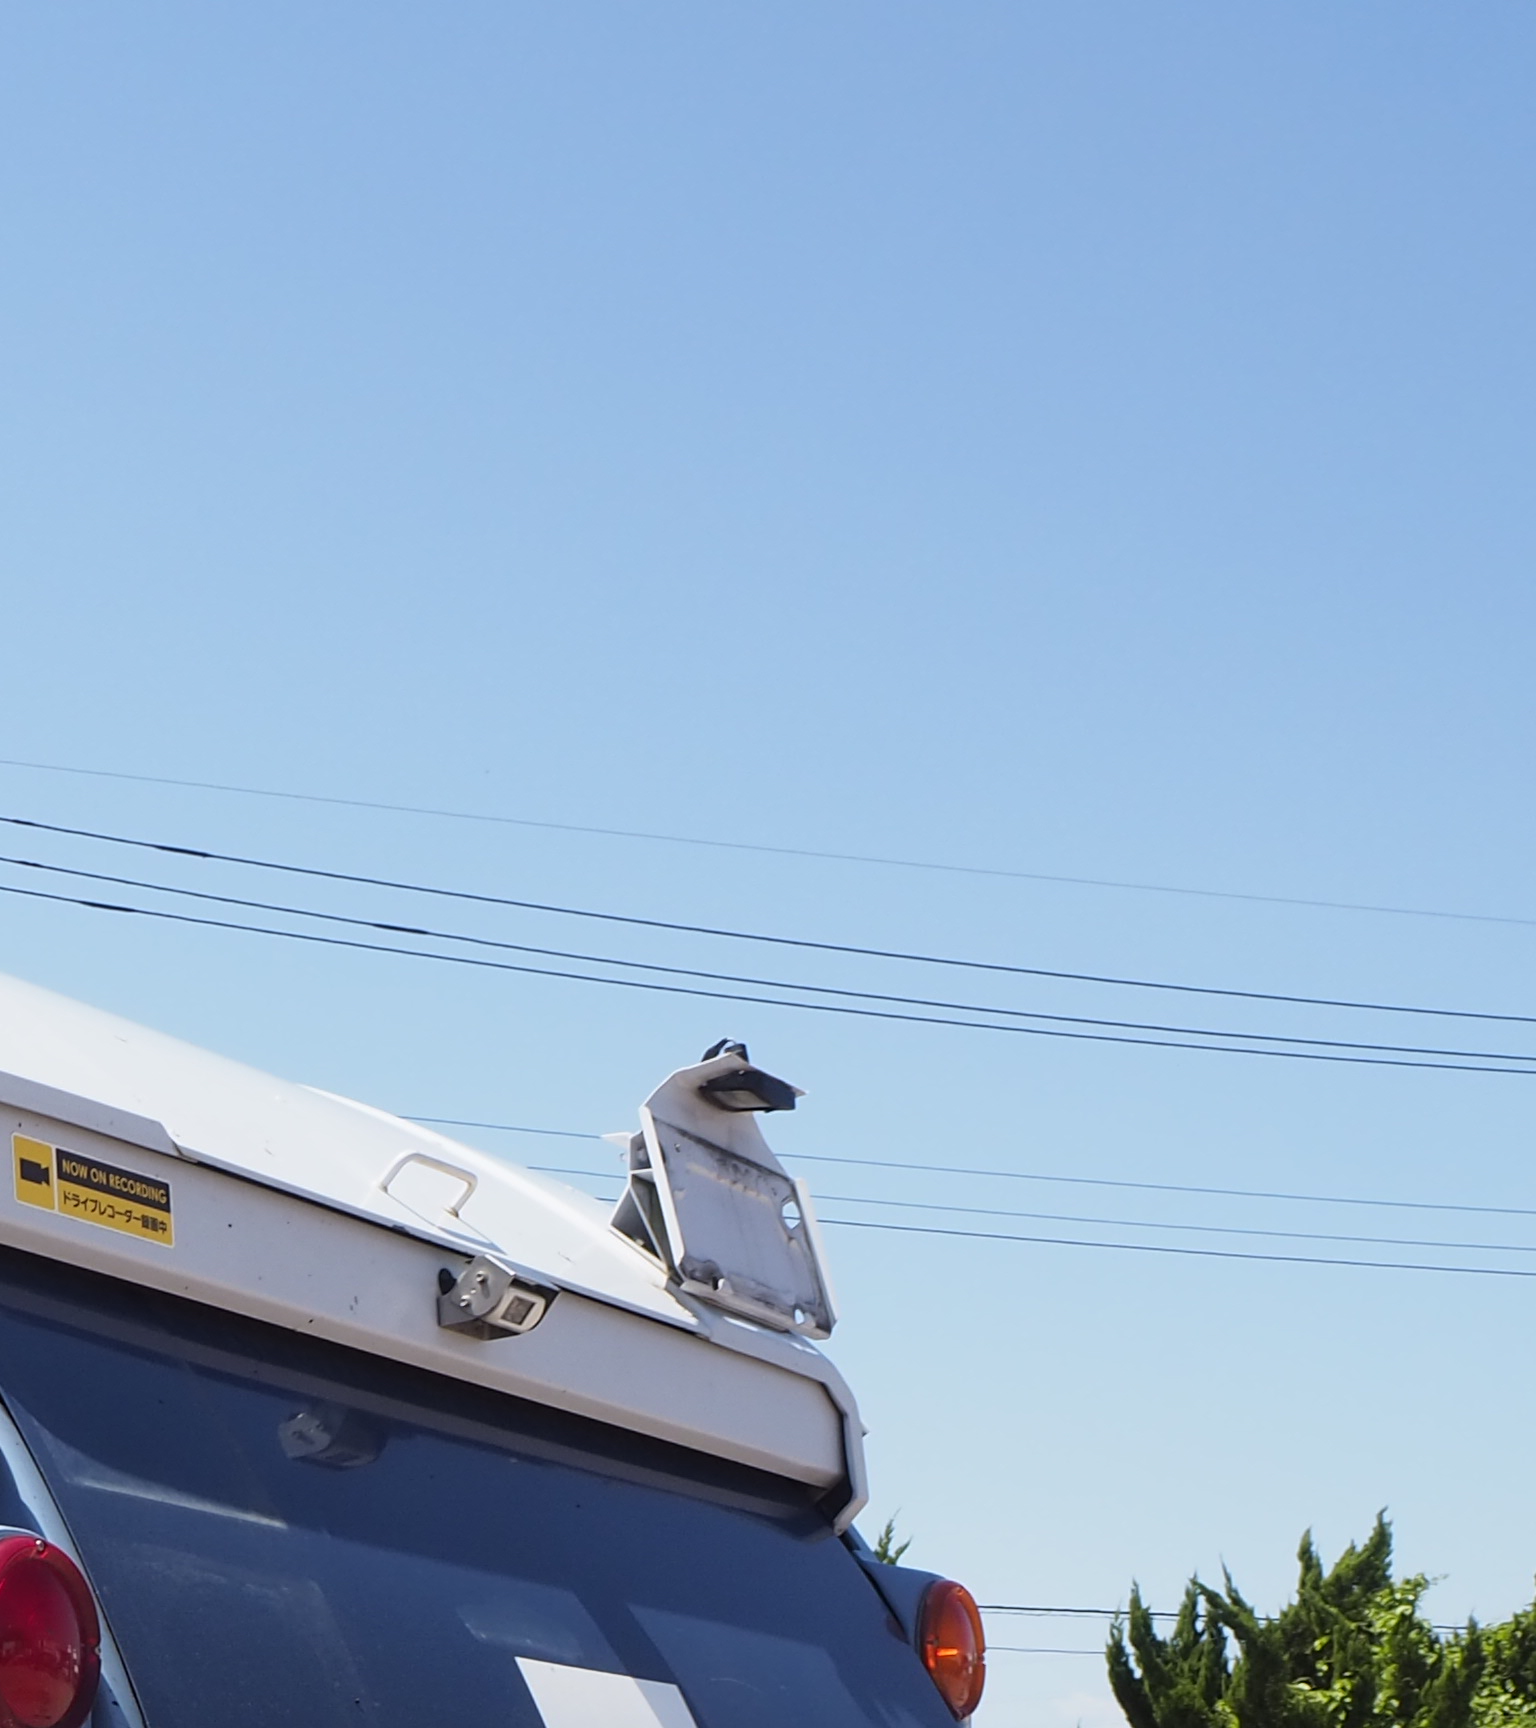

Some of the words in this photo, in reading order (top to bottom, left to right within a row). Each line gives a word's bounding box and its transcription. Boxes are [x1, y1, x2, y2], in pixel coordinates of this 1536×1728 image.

[61, 1159, 88, 1180] NOW
[90, 1167, 107, 1186] ON
[109, 1173, 167, 1205] RECORDING
